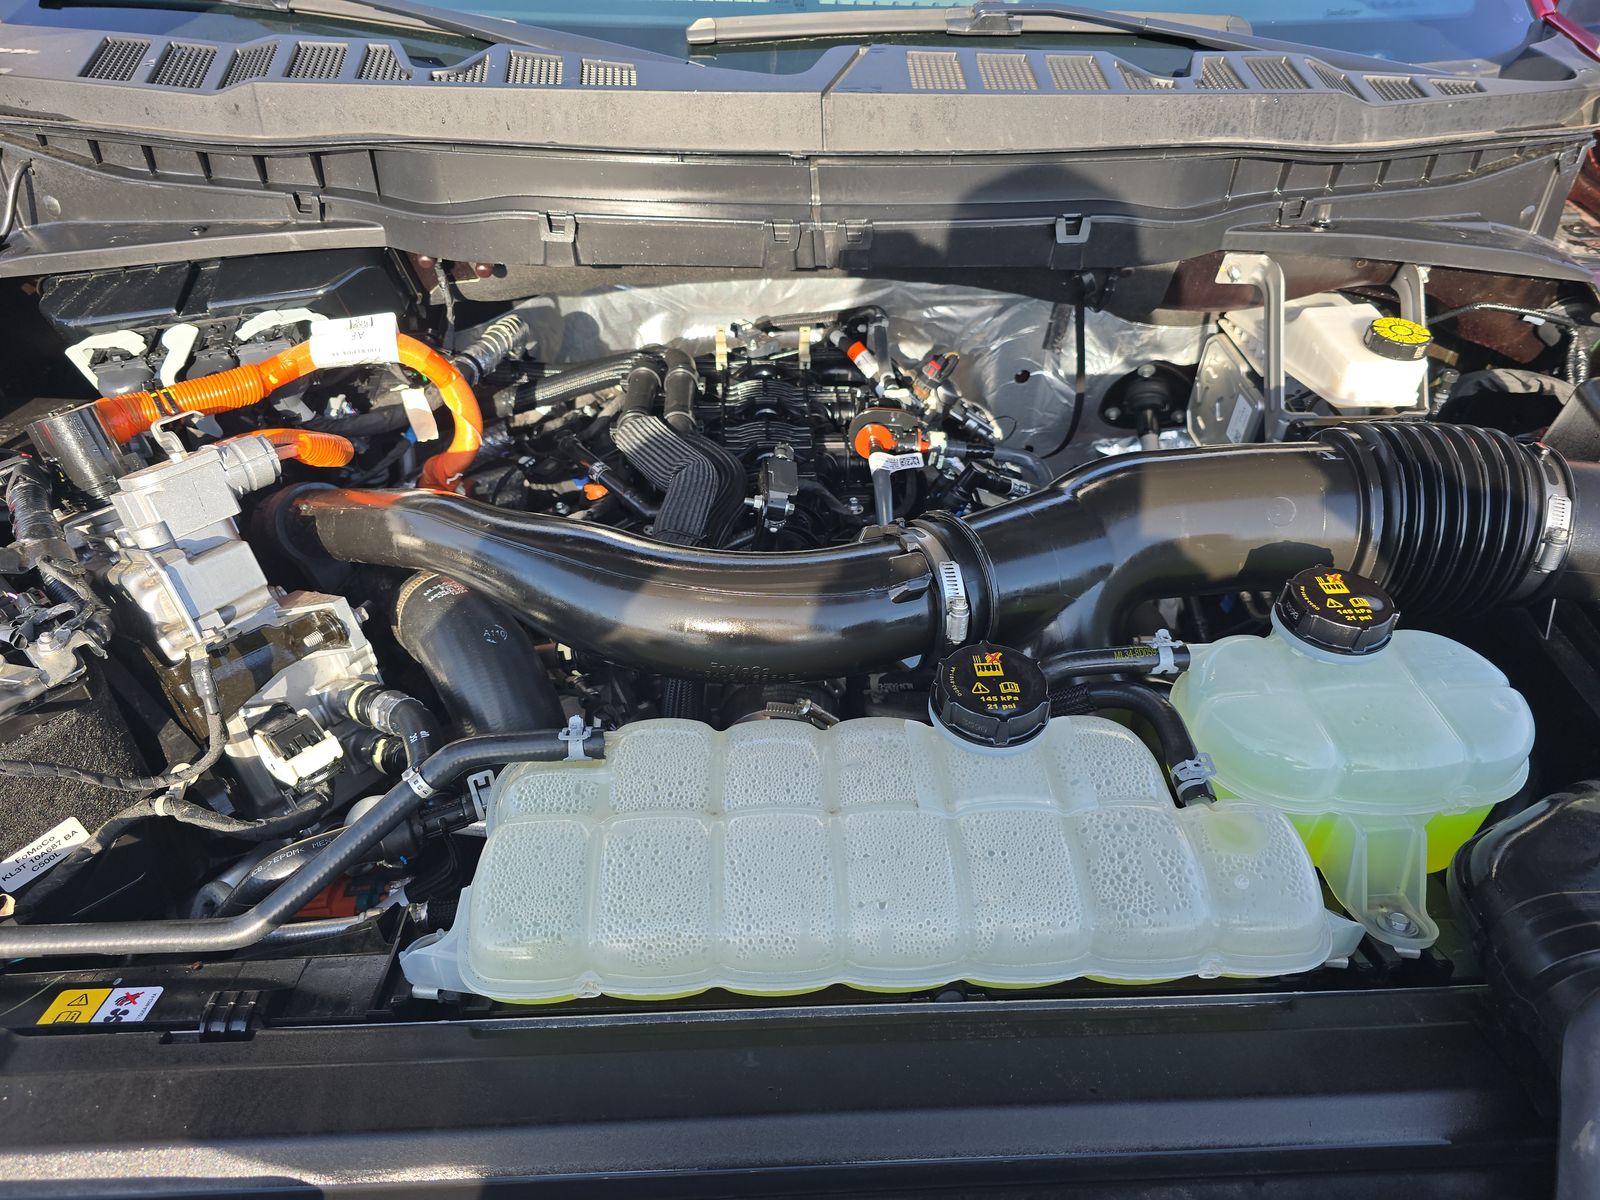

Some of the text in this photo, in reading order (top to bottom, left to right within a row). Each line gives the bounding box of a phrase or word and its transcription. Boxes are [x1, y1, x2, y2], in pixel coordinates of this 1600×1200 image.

[1002, 703, 1016, 711] psi
[1, 862, 27, 882] KL3T
[63, 829, 79, 841] BA
[14, 835, 56, 864] FoMoCo
[31, 852, 61, 872] C500L
